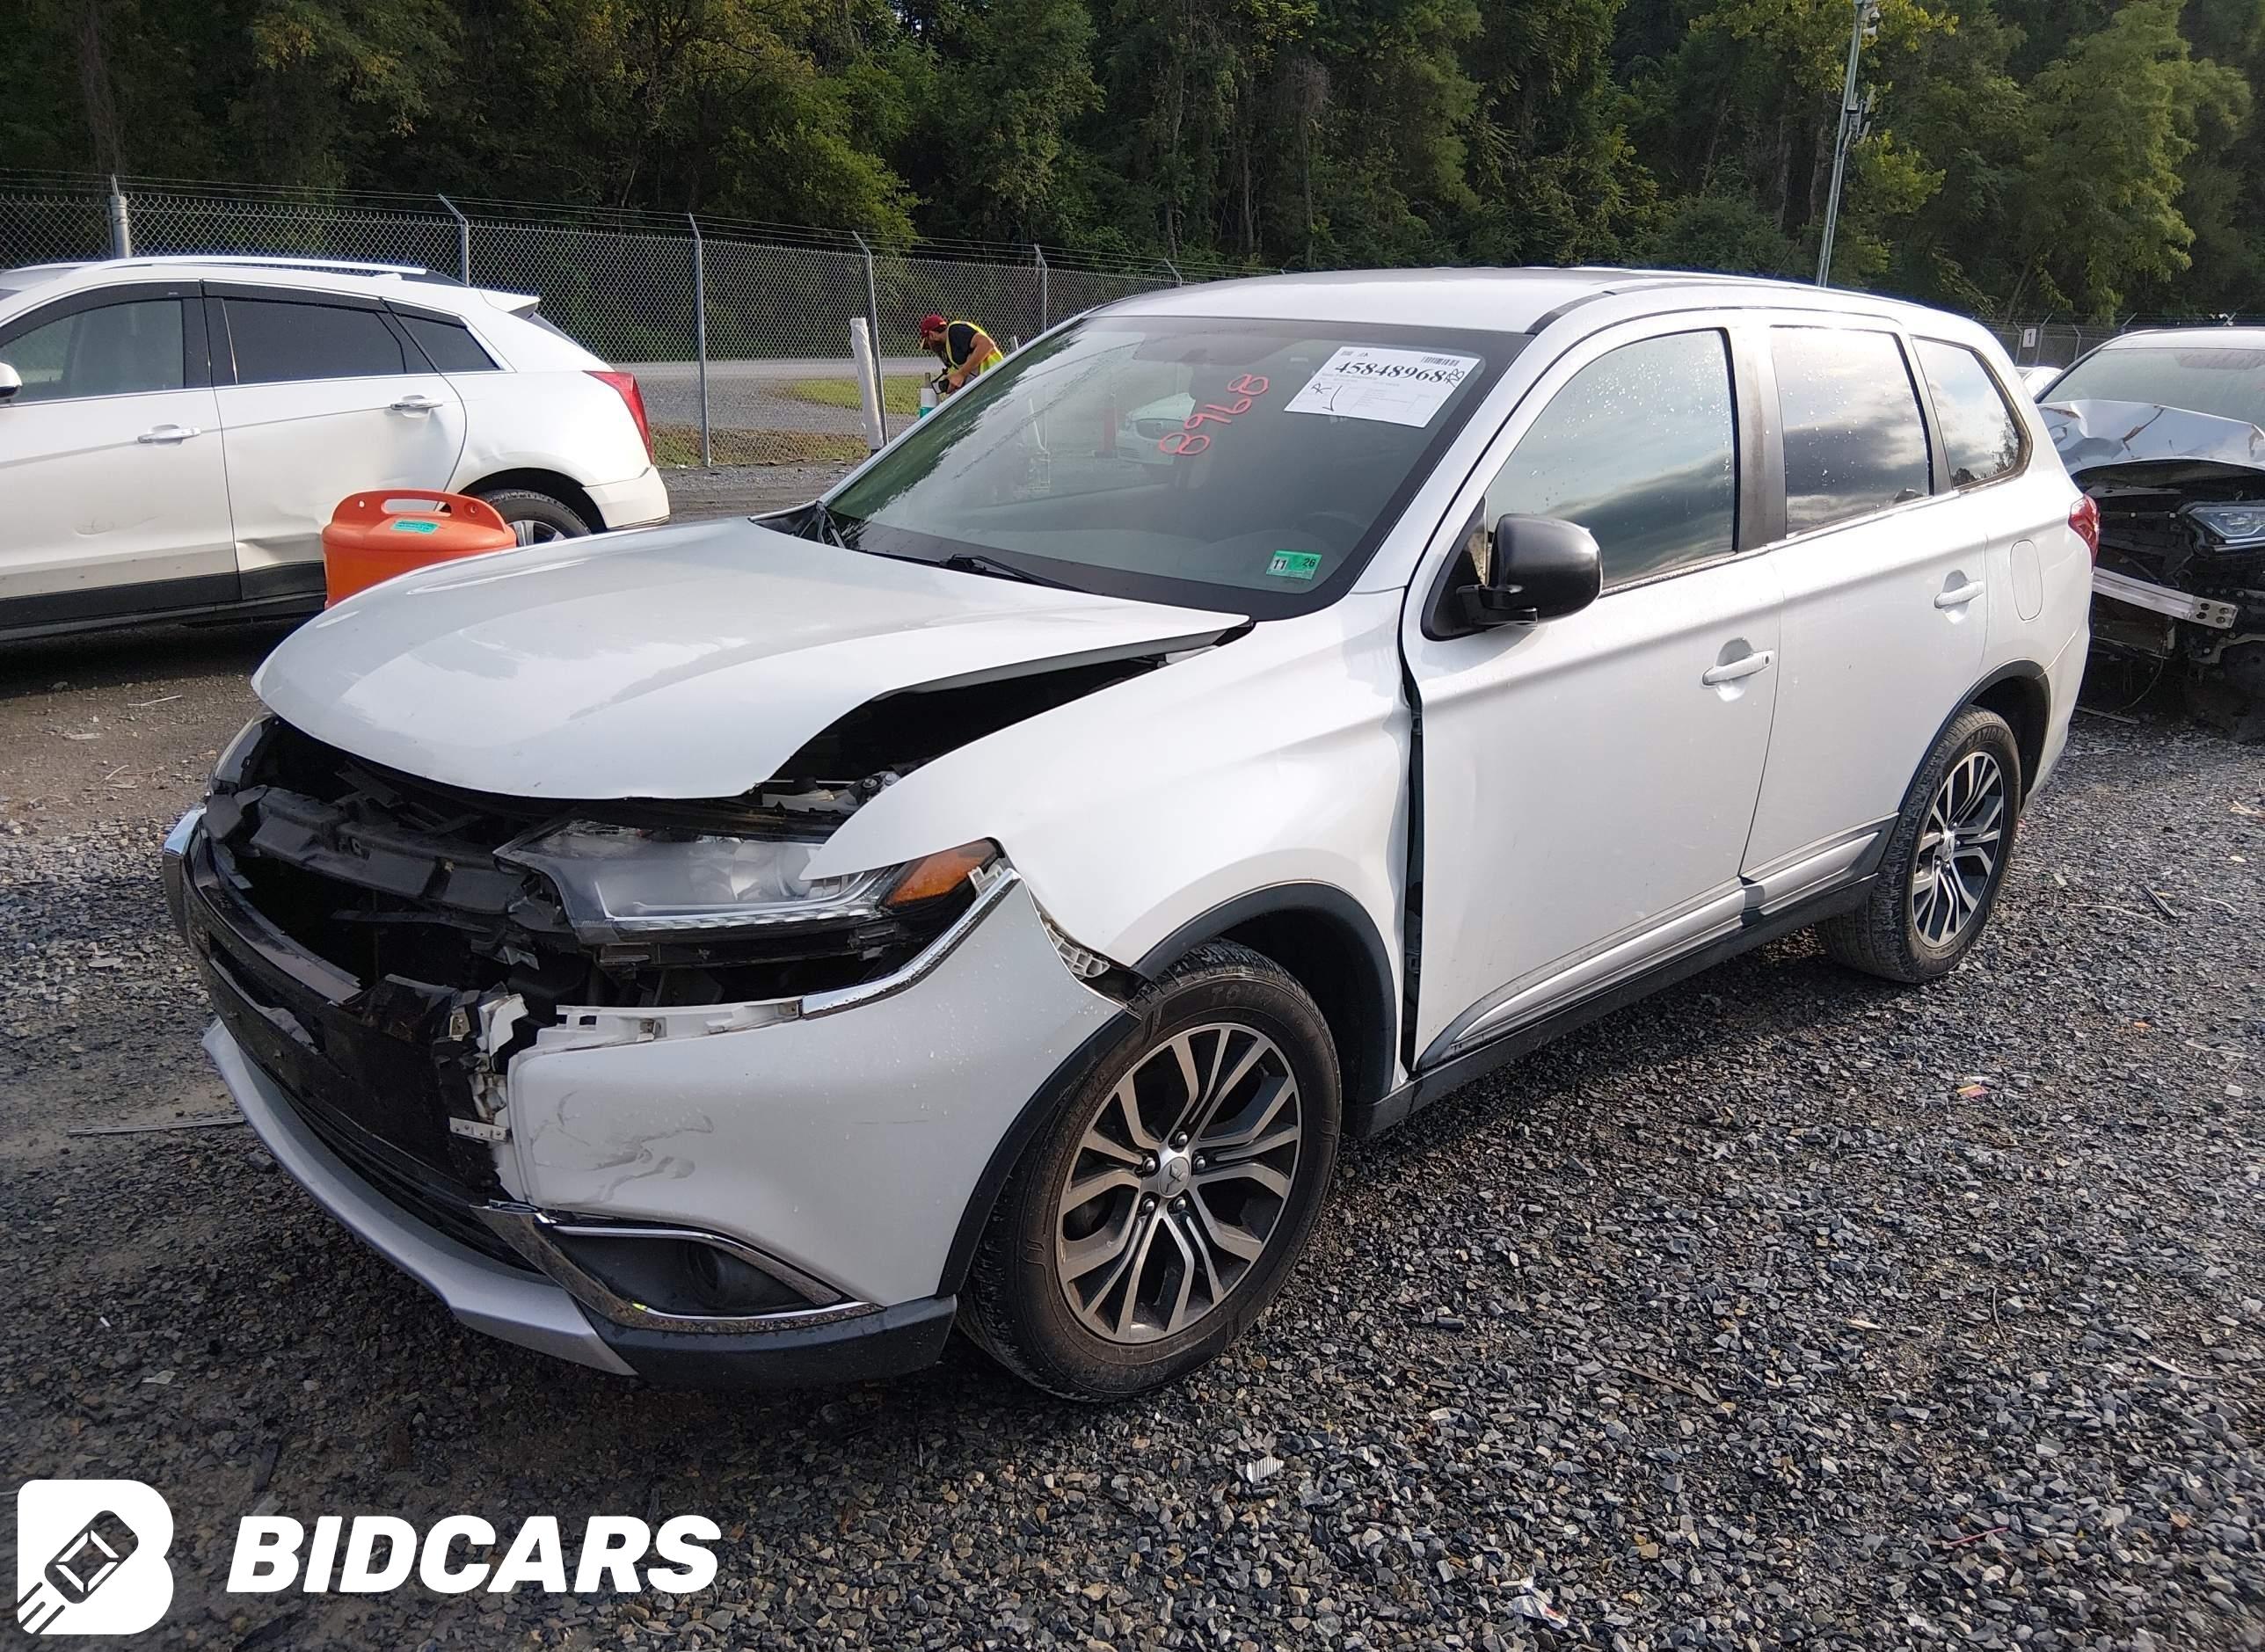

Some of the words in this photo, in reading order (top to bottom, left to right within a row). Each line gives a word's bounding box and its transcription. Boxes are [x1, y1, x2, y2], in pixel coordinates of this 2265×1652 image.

[1335, 361, 1447, 383] 45848968
[1158, 373, 1270, 456] 8968
[1273, 558, 1287, 570] 11
